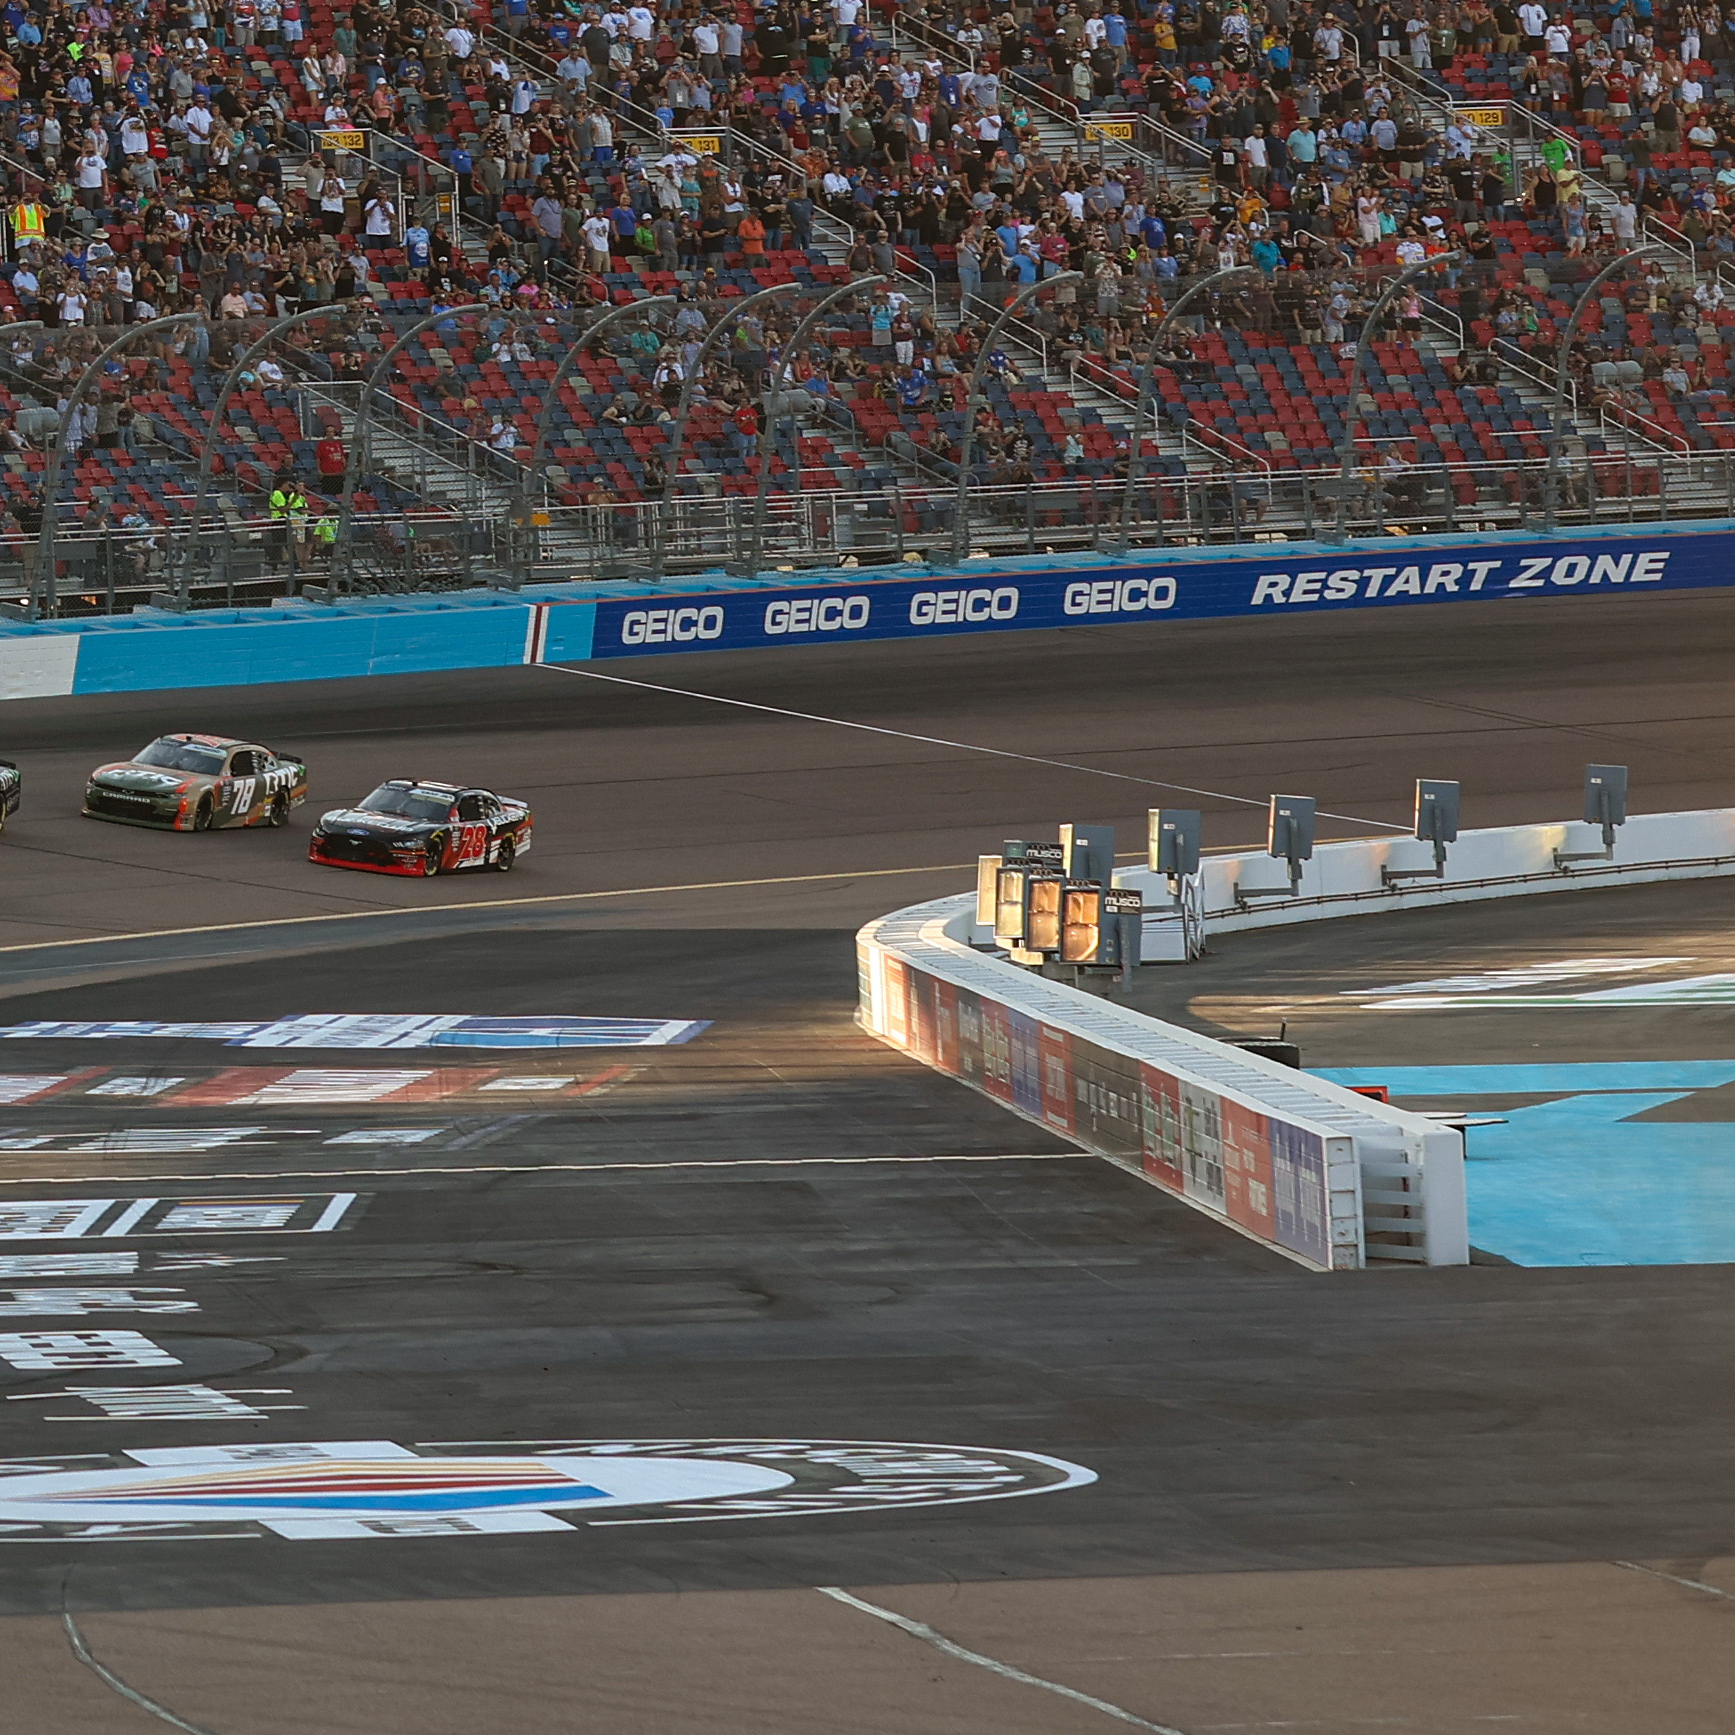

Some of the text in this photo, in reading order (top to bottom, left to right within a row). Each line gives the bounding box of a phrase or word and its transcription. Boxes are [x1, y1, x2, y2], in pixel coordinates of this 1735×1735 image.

[1479, 110, 1499, 123] 129
[1064, 576, 1177, 615] GEICO
[1250, 552, 1671, 606] RESTART ZONE
[621, 605, 725, 645] GEICO
[763, 595, 870, 635] GEICO
[909, 587, 1019, 625] GEICO
[230, 778, 256, 815] 78
[459, 824, 487, 861] 28
